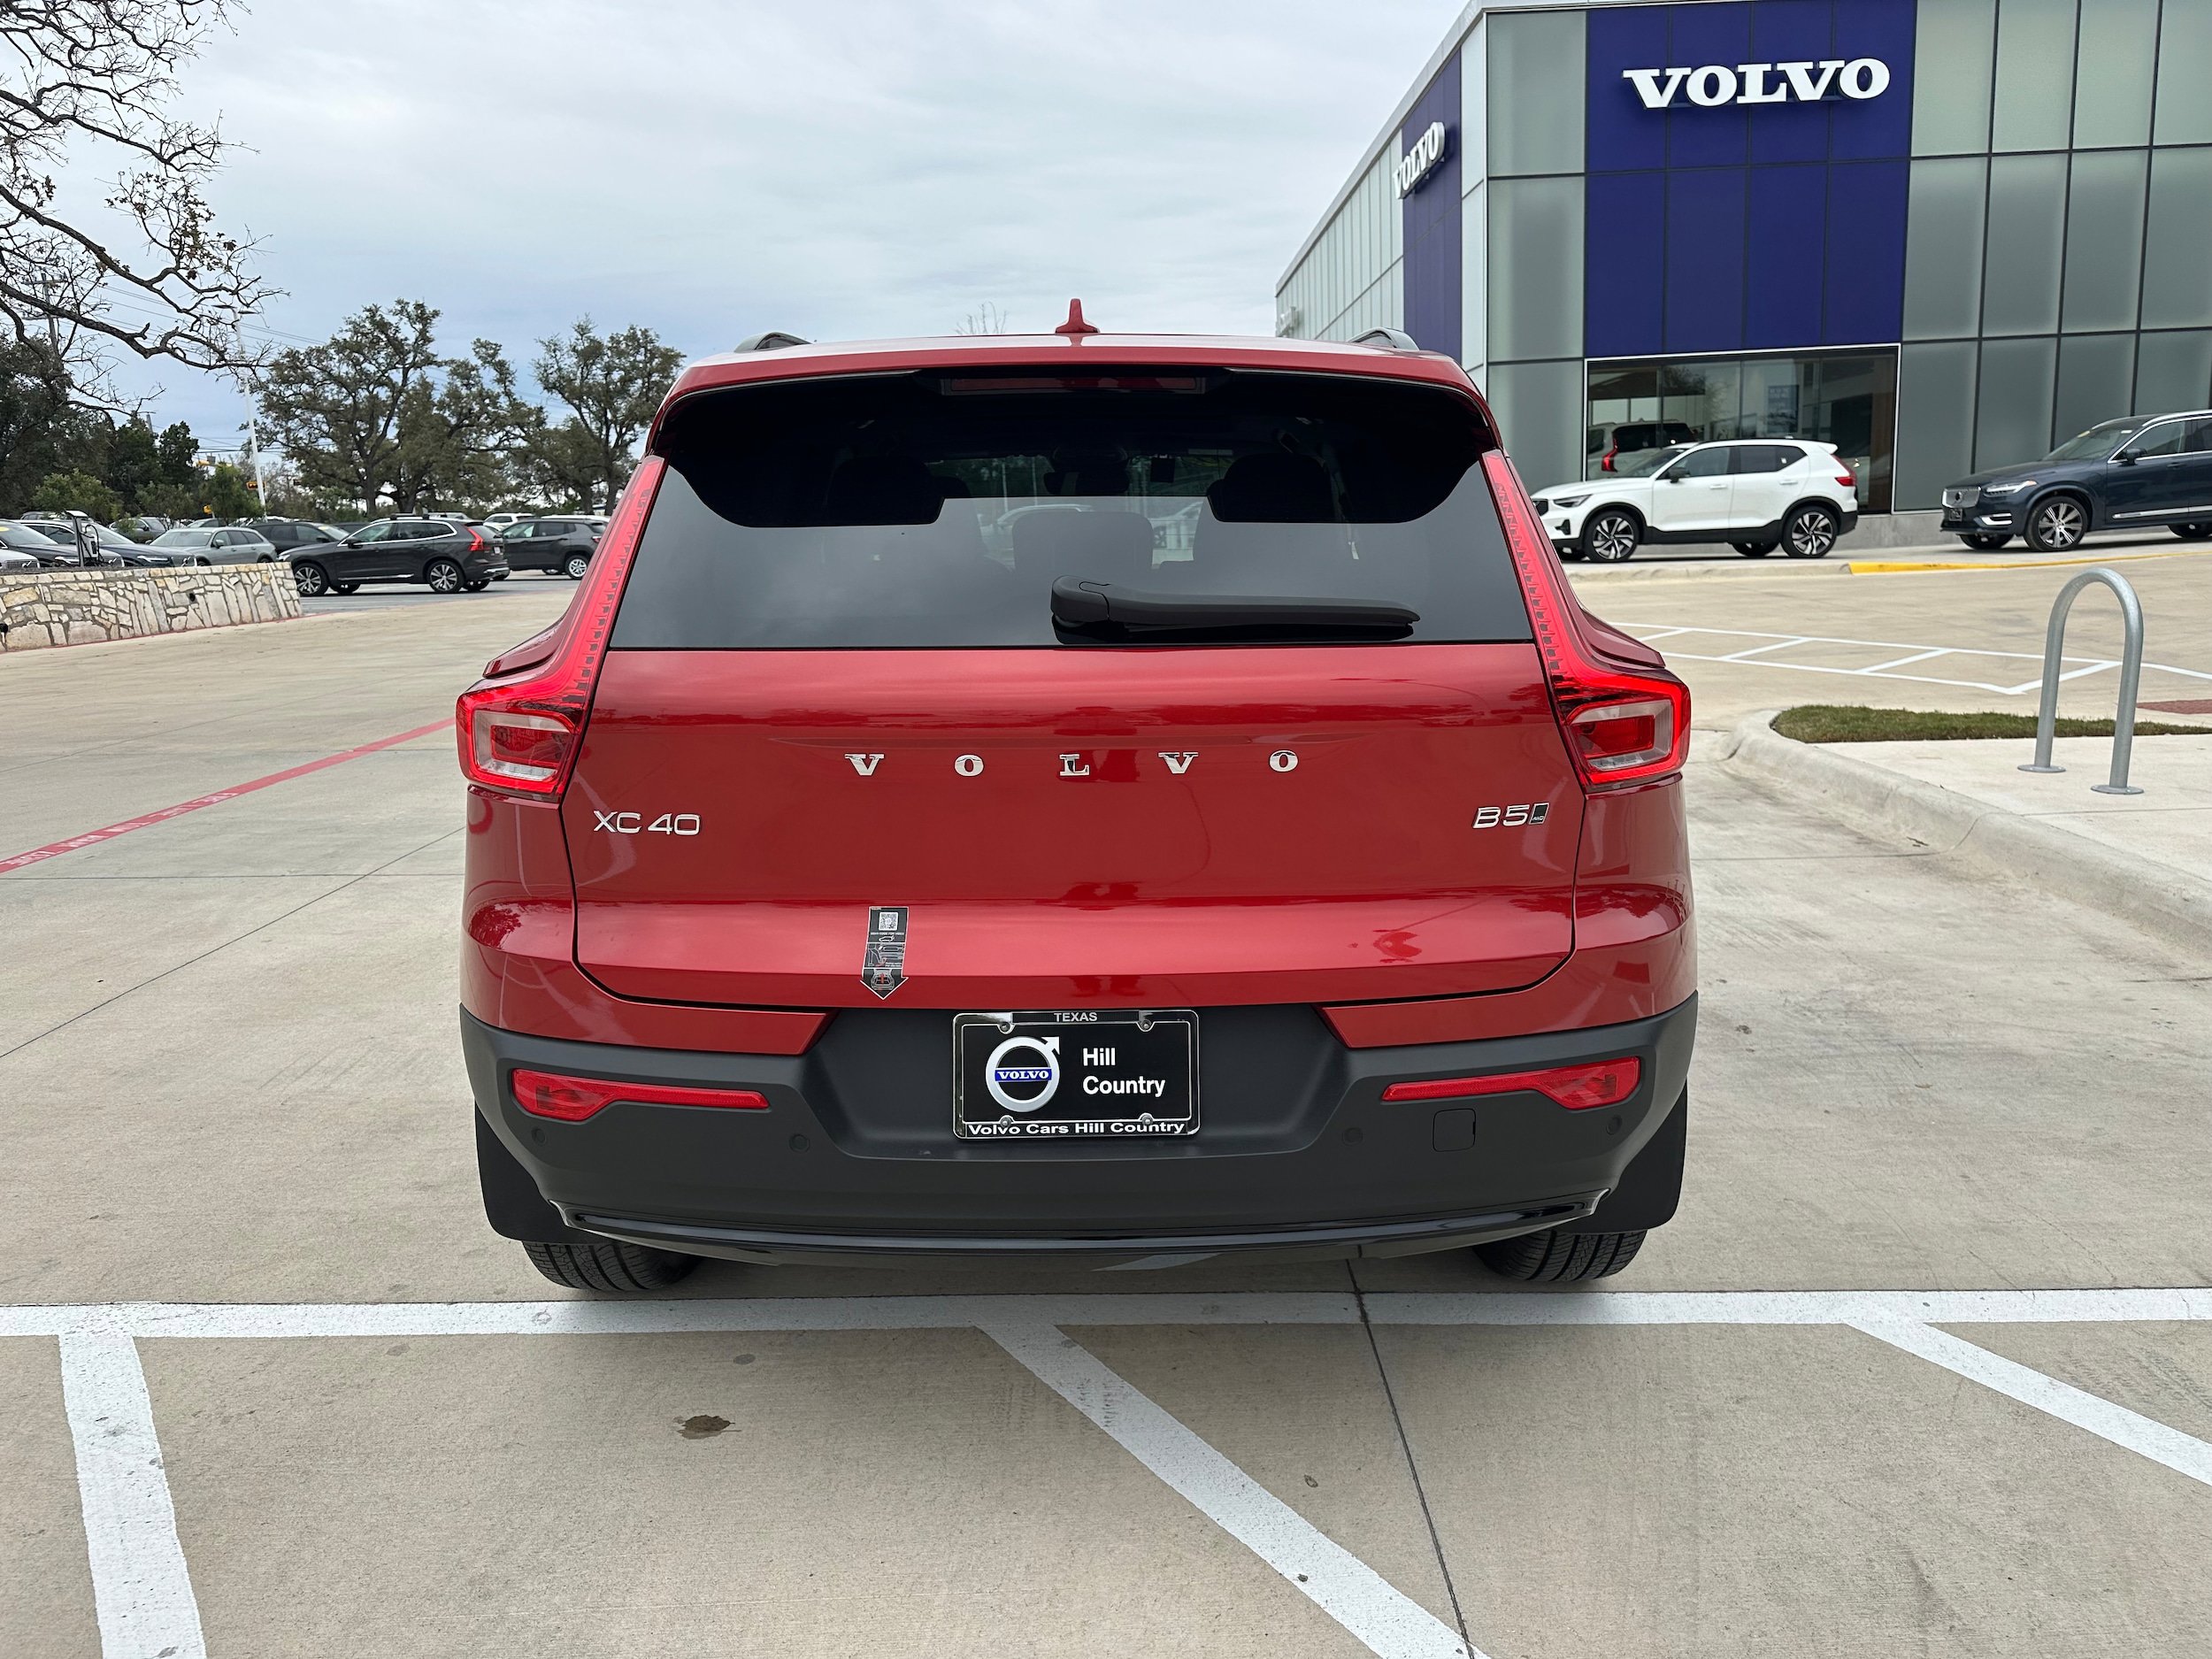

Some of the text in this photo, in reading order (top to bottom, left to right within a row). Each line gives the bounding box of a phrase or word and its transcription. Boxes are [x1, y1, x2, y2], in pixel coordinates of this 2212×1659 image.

[1623, 58, 1890, 108] VOLVO
[1393, 121, 1445, 199] VOLVO
[844, 749, 1299, 777] VOLVO
[1472, 803, 1530, 828] B5
[1054, 1011, 1098, 1023] TEXAS
[1082, 1047, 1117, 1066] Hill
[997, 1070, 1050, 1079] VOLVO
[1082, 1075, 1166, 1097] Country
[969, 1121, 1186, 1135] Volvo Cars Hill Country
